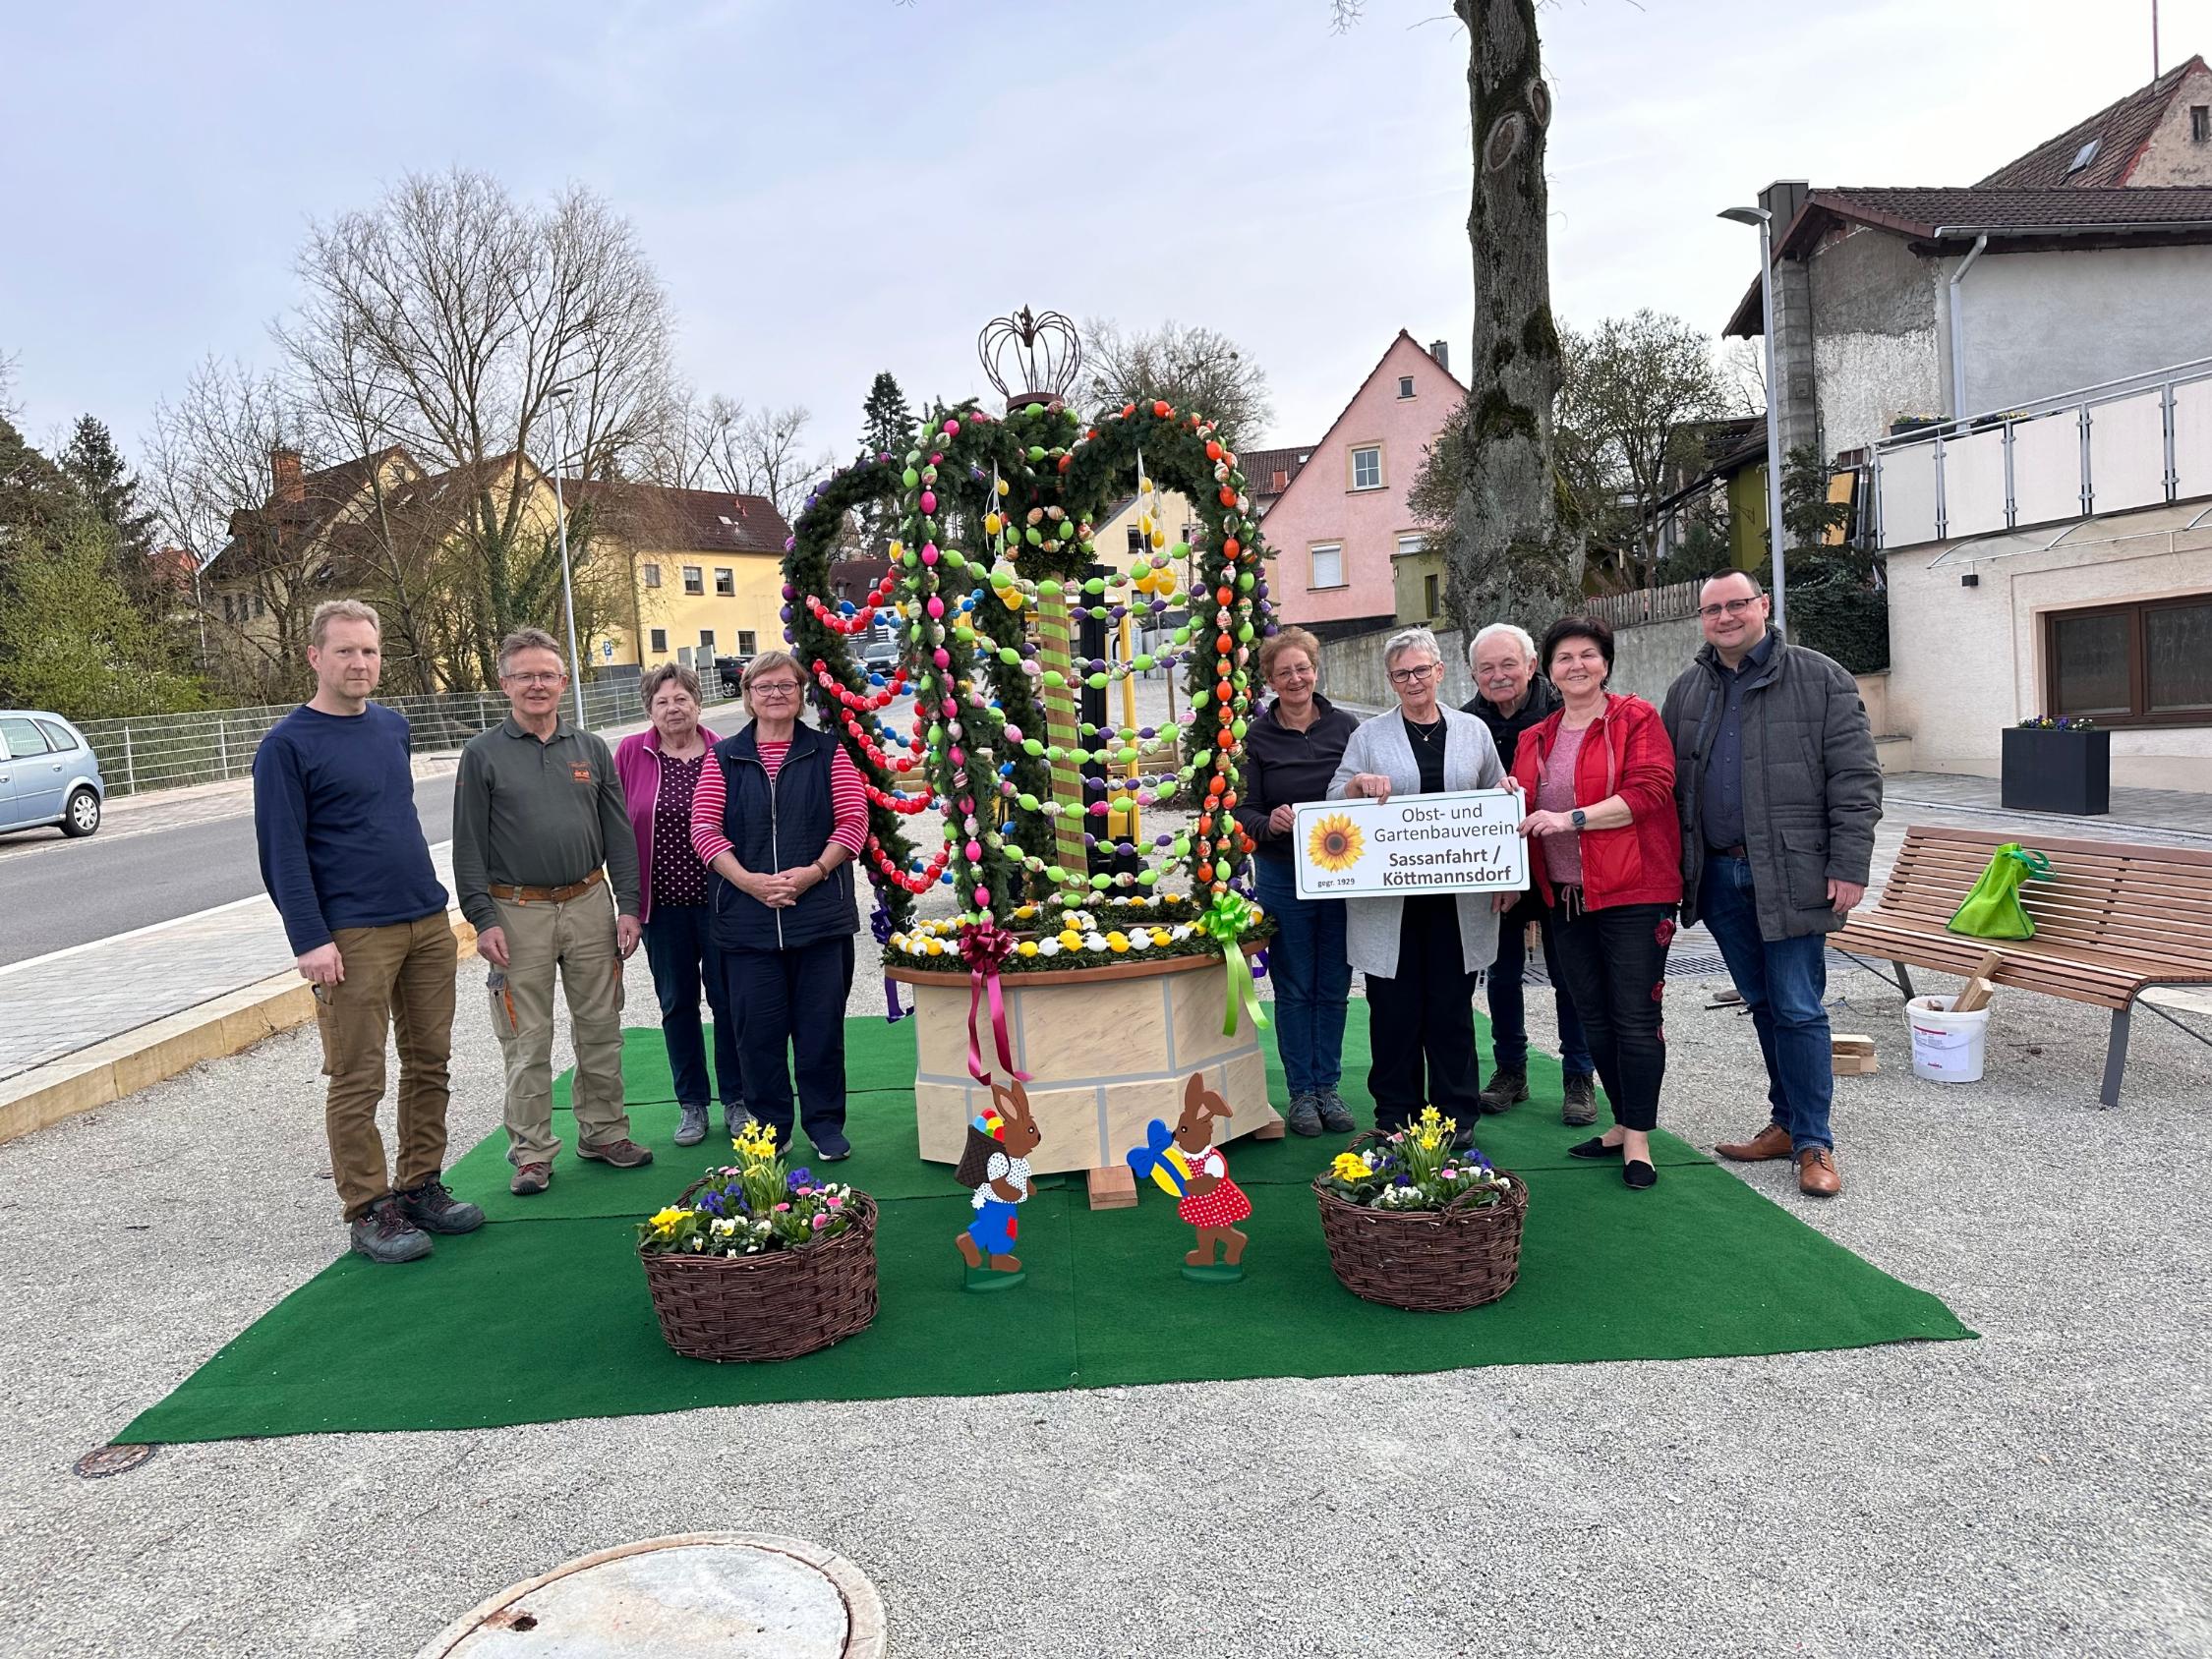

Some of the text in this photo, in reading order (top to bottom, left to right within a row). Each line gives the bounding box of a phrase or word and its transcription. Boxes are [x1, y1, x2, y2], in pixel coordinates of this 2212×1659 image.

[1402, 802, 1483, 823] Obst- und
[1374, 821, 1514, 842] Gartenbauverein
[1389, 844, 1501, 867] Sassanfahrt /
[1317, 880, 1335, 888] gegr.
[1382, 865, 1512, 887] Köttmannsdorf
